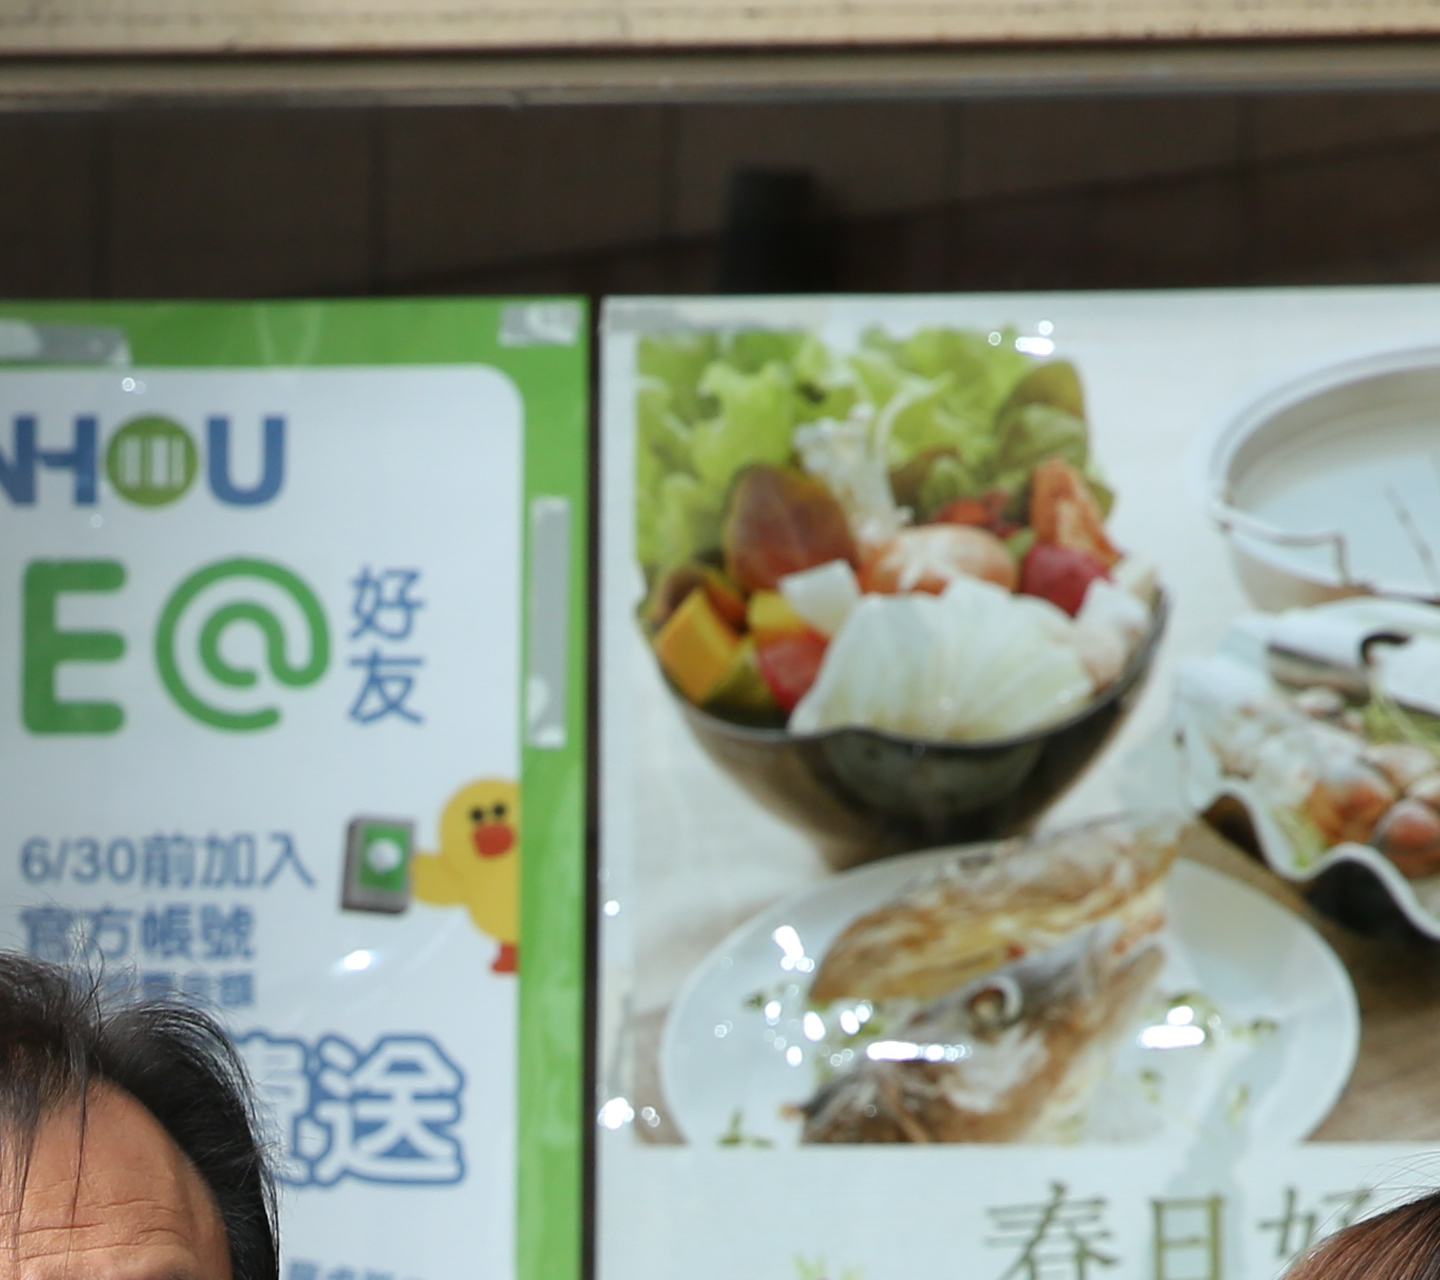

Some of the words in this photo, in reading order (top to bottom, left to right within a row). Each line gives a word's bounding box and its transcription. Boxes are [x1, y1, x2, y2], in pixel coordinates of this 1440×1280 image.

[346, 563, 427, 727] 好友
[20, 833, 317, 890] 6/30前加入
